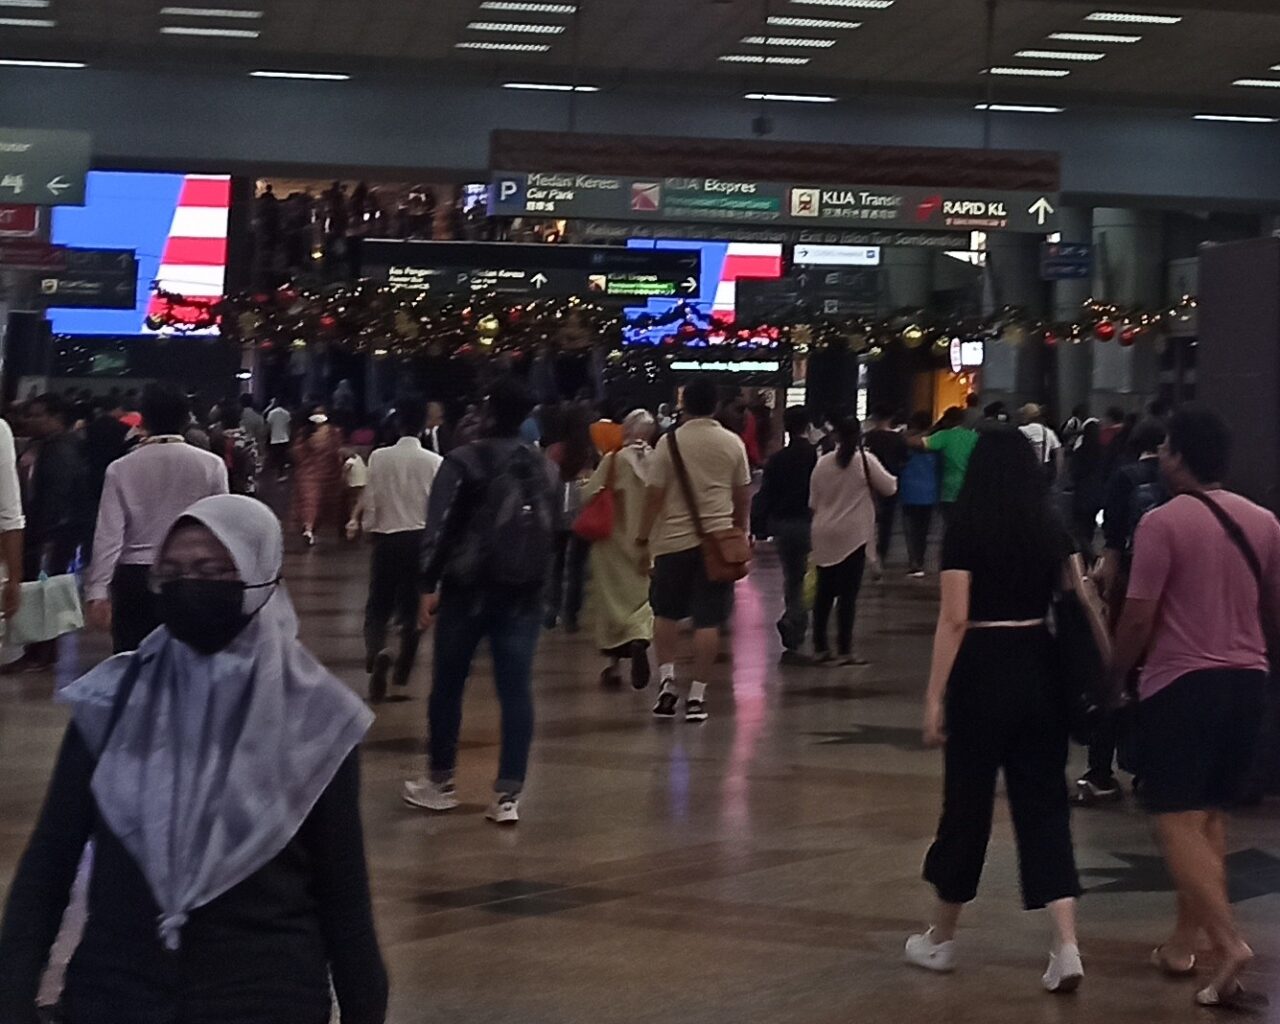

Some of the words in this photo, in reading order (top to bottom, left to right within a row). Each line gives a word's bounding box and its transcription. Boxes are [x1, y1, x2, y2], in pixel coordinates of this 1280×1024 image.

[527, 173, 572, 188] Medan
[704, 178, 757, 194] Ekspres
[527, 188, 546, 200] Car
[548, 189, 574, 201] Park
[822, 190, 856, 205] KLIA
[943, 200, 985, 216] RAPID
[988, 201, 1007, 216] KL
